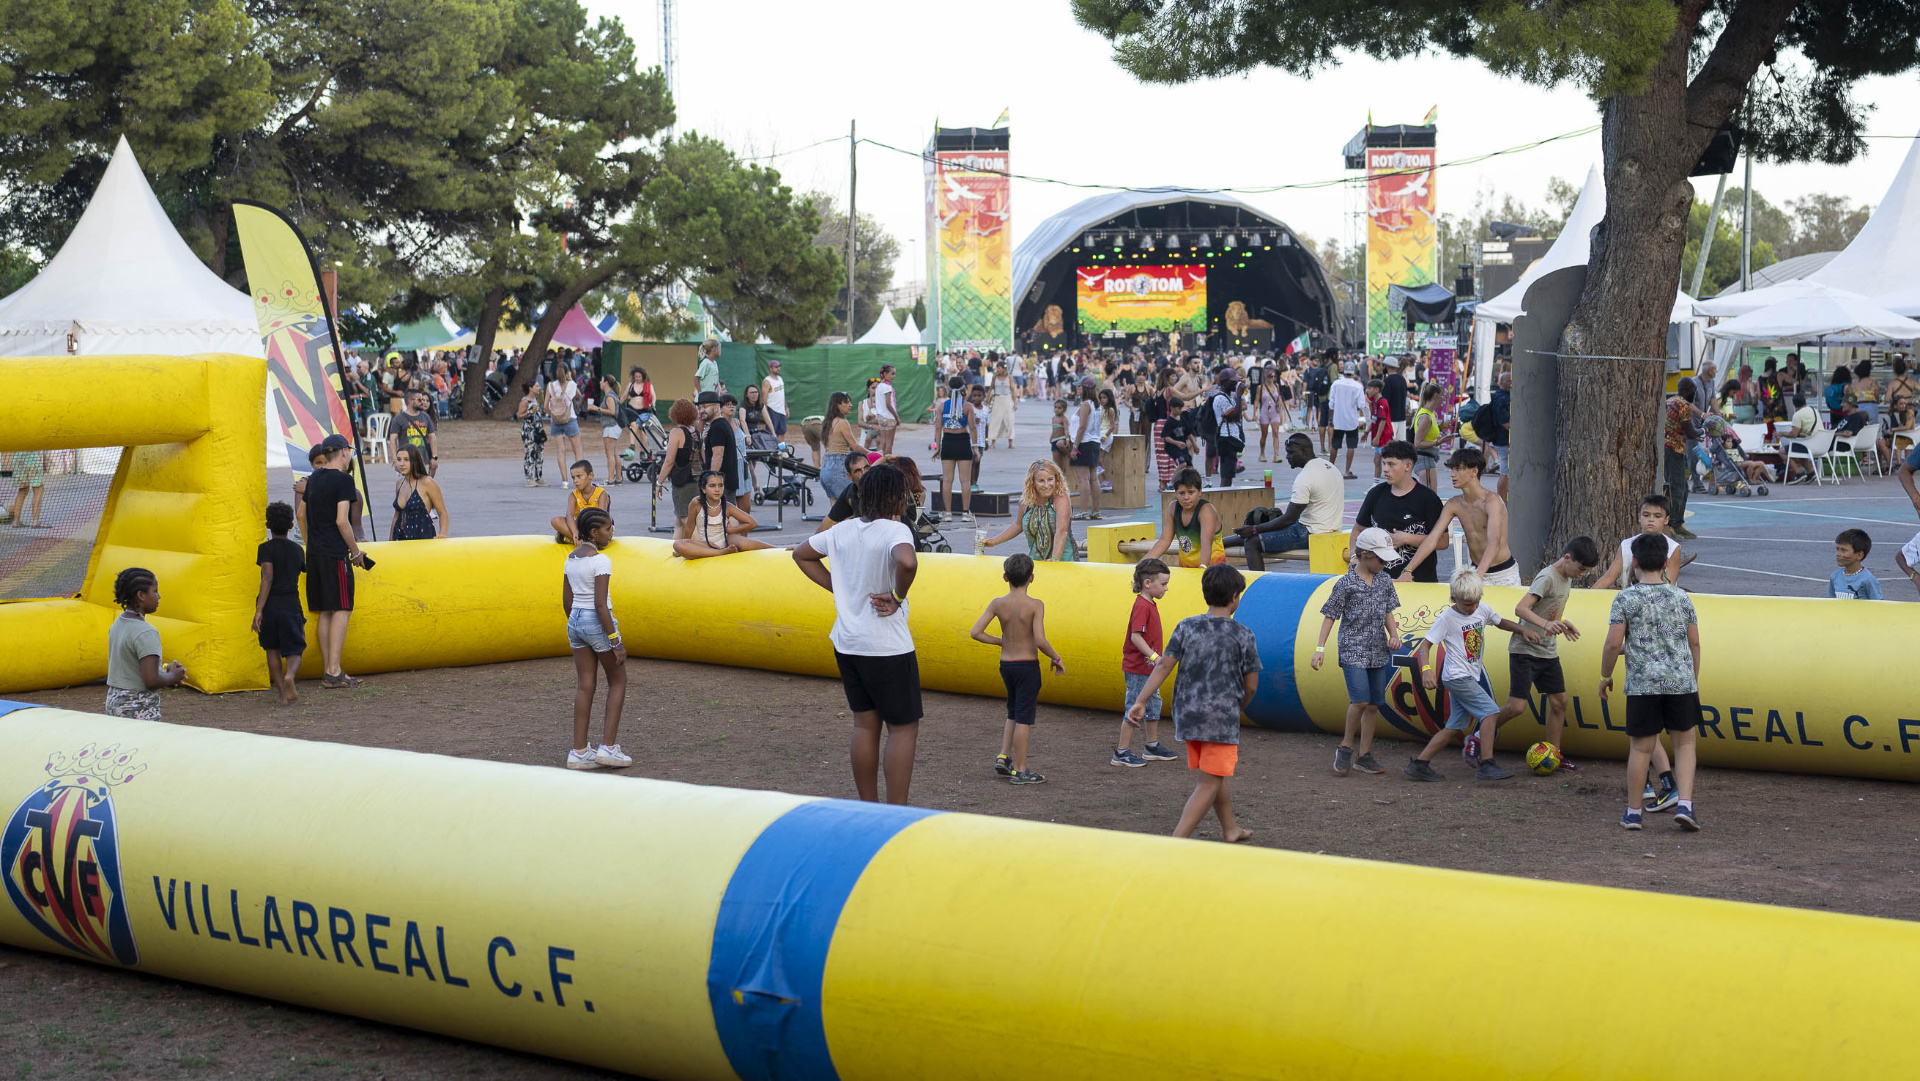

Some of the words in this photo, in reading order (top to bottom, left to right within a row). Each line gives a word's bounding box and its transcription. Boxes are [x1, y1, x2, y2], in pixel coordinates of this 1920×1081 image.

[1526, 693, 1824, 747] VLLREAL
[153, 875, 470, 988] VILLARREAL
[486, 935, 596, 1013] C.F.
